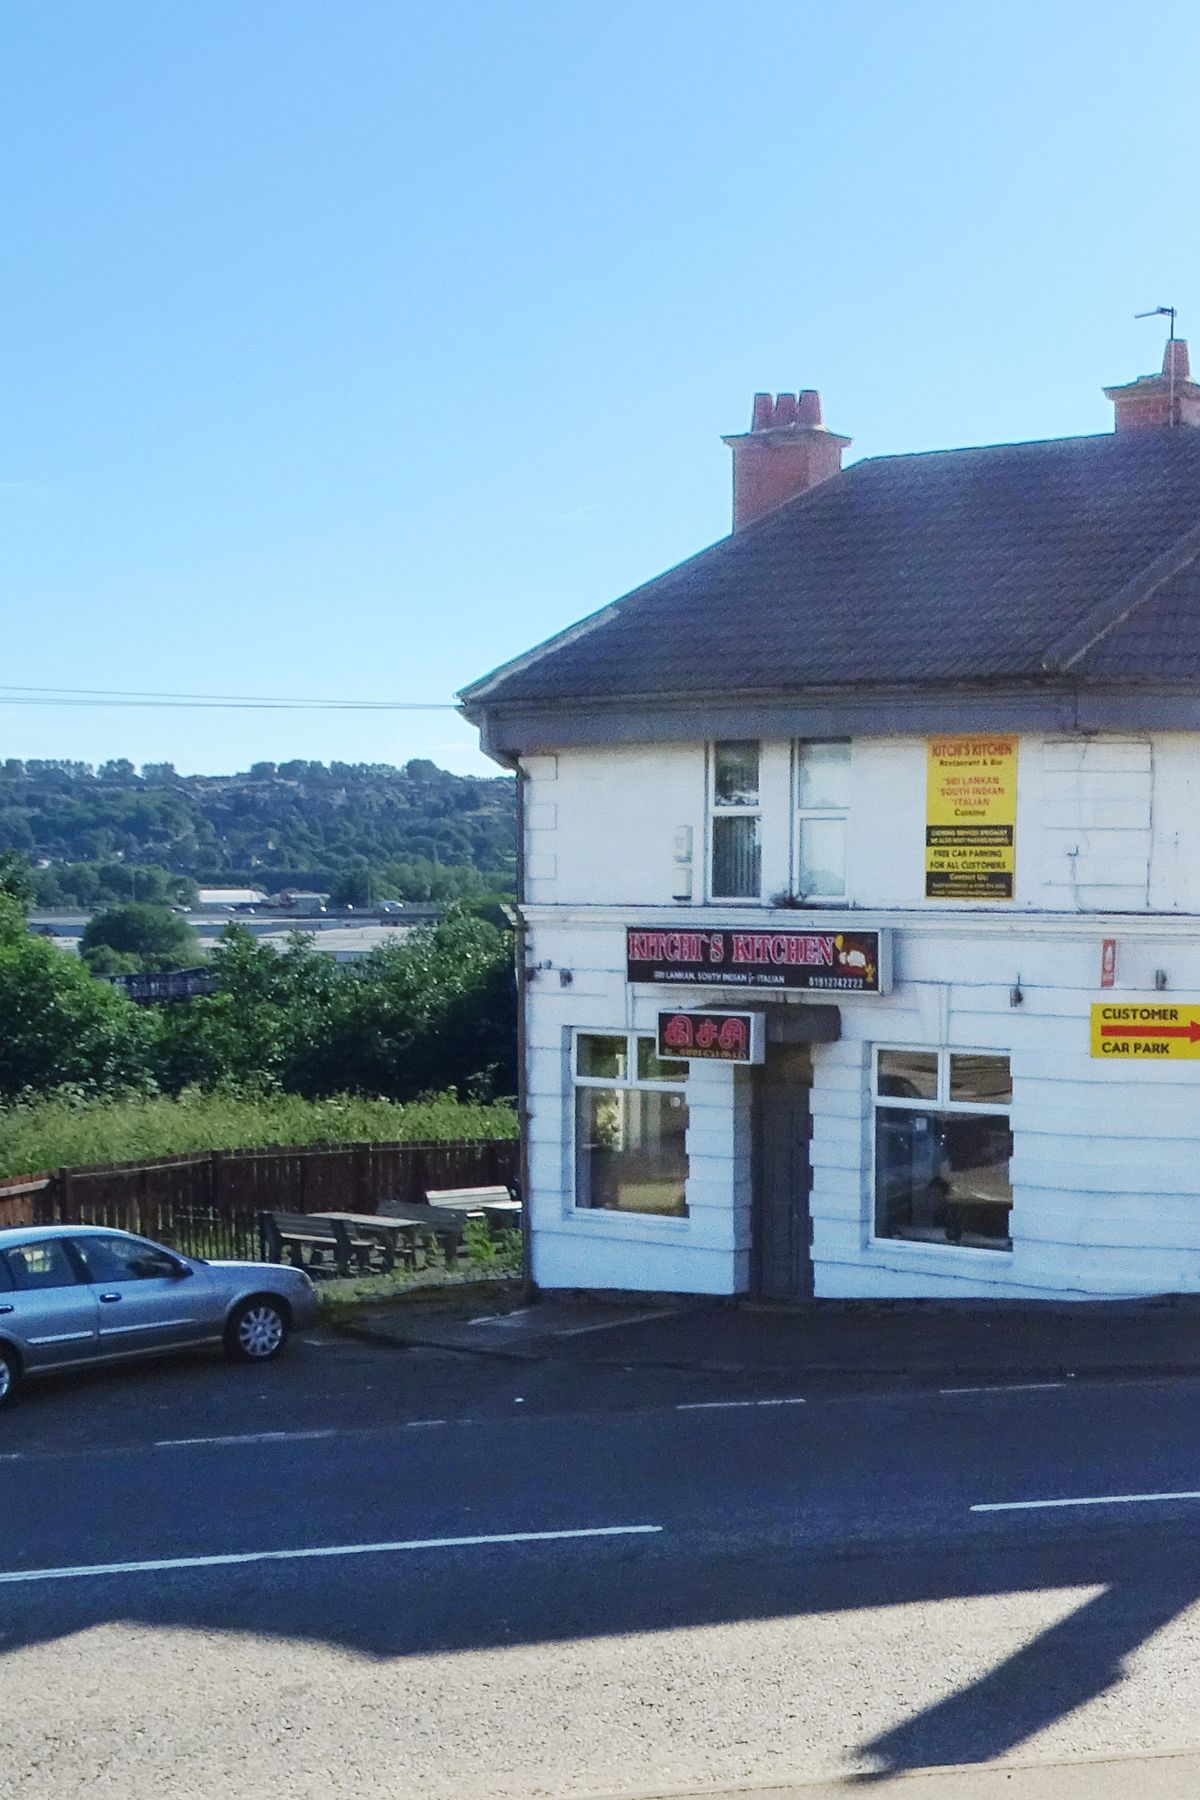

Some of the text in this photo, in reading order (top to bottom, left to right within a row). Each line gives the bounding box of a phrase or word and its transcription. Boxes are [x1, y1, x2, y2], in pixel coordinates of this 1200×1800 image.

[972, 742, 1012, 756] KITCHEN
[962, 776, 999, 785] LANKAN
[941, 787, 1004, 796] SOUTH INDIAN
[953, 798, 990, 807] ITALIAN
[933, 850, 1003, 858] FREE CAR PARKING
[930, 861, 1006, 870] FOR ALL CUSTOMERS
[732, 934, 834, 966] KITCHEN
[697, 972, 721, 981] SOUTH
[722, 973, 747, 982] INDIAN
[757, 974, 785, 984] ITALIAN
[1102, 1008, 1178, 1021] CUSTOMER
[1102, 1041, 1170, 1054] CAR PARK
